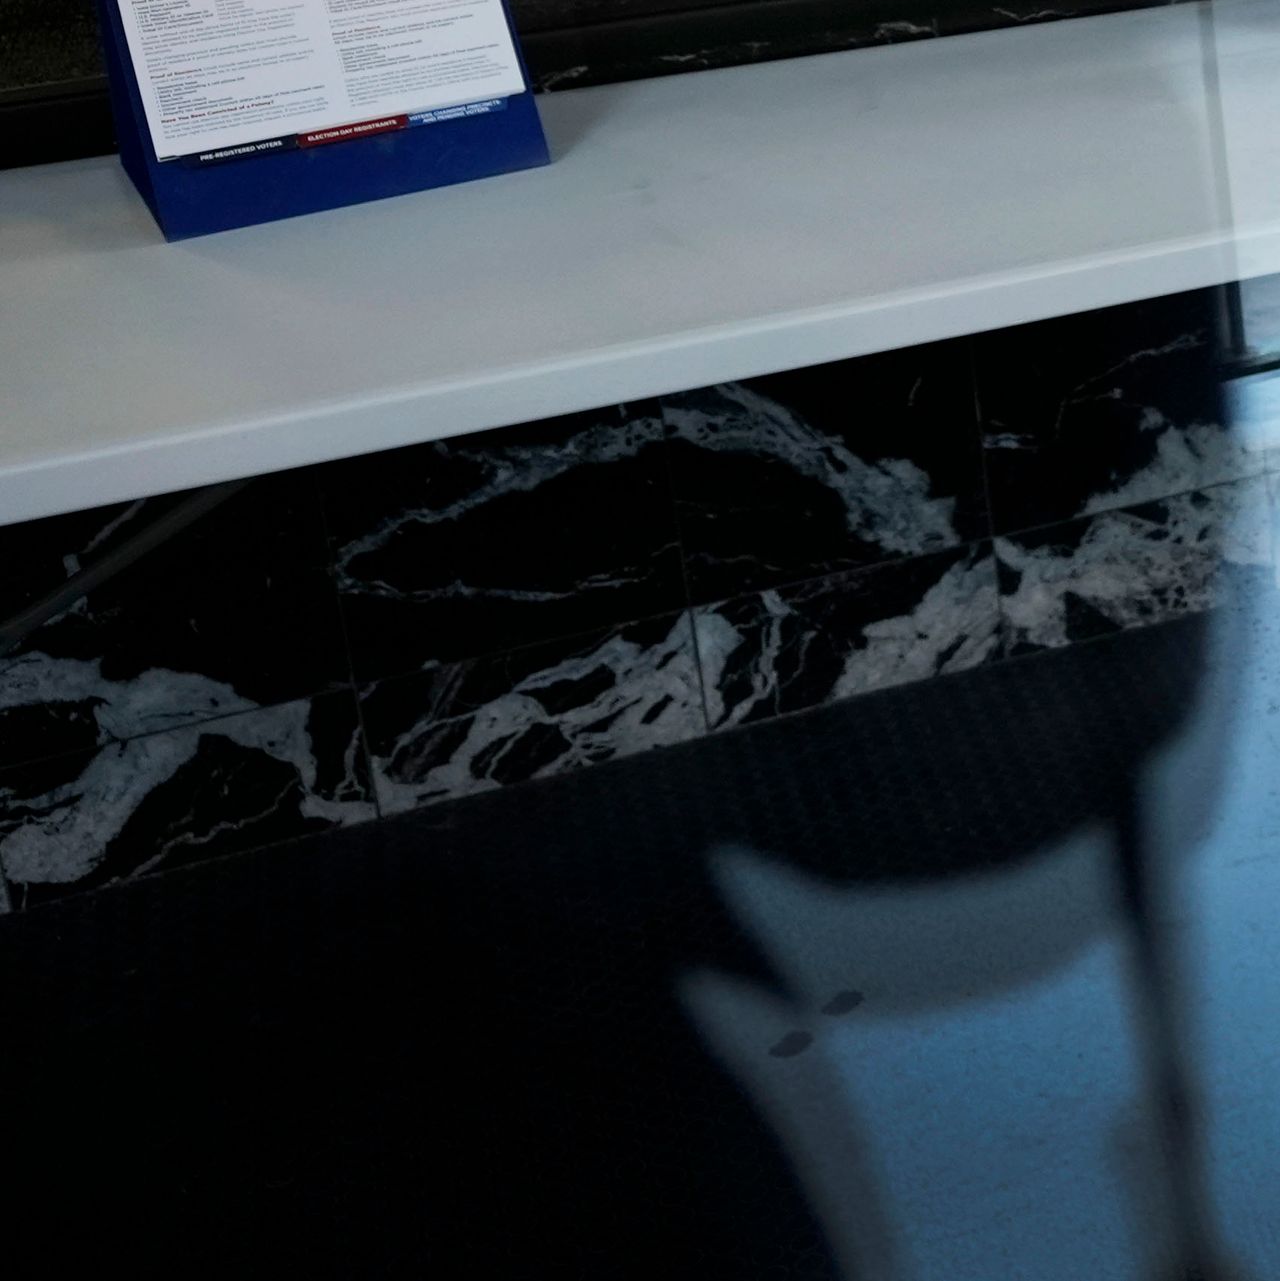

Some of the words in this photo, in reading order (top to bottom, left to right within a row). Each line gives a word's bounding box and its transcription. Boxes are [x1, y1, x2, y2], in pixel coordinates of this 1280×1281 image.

[207, 106, 238, 116] Convicted
[308, 130, 340, 142] ELECTION
[340, 128, 352, 136] DAY
[353, 119, 397, 134] REGISTRANTS
[200, 146, 256, 162] PRE-REGISTERED
[256, 140, 282, 152] VOTERS
